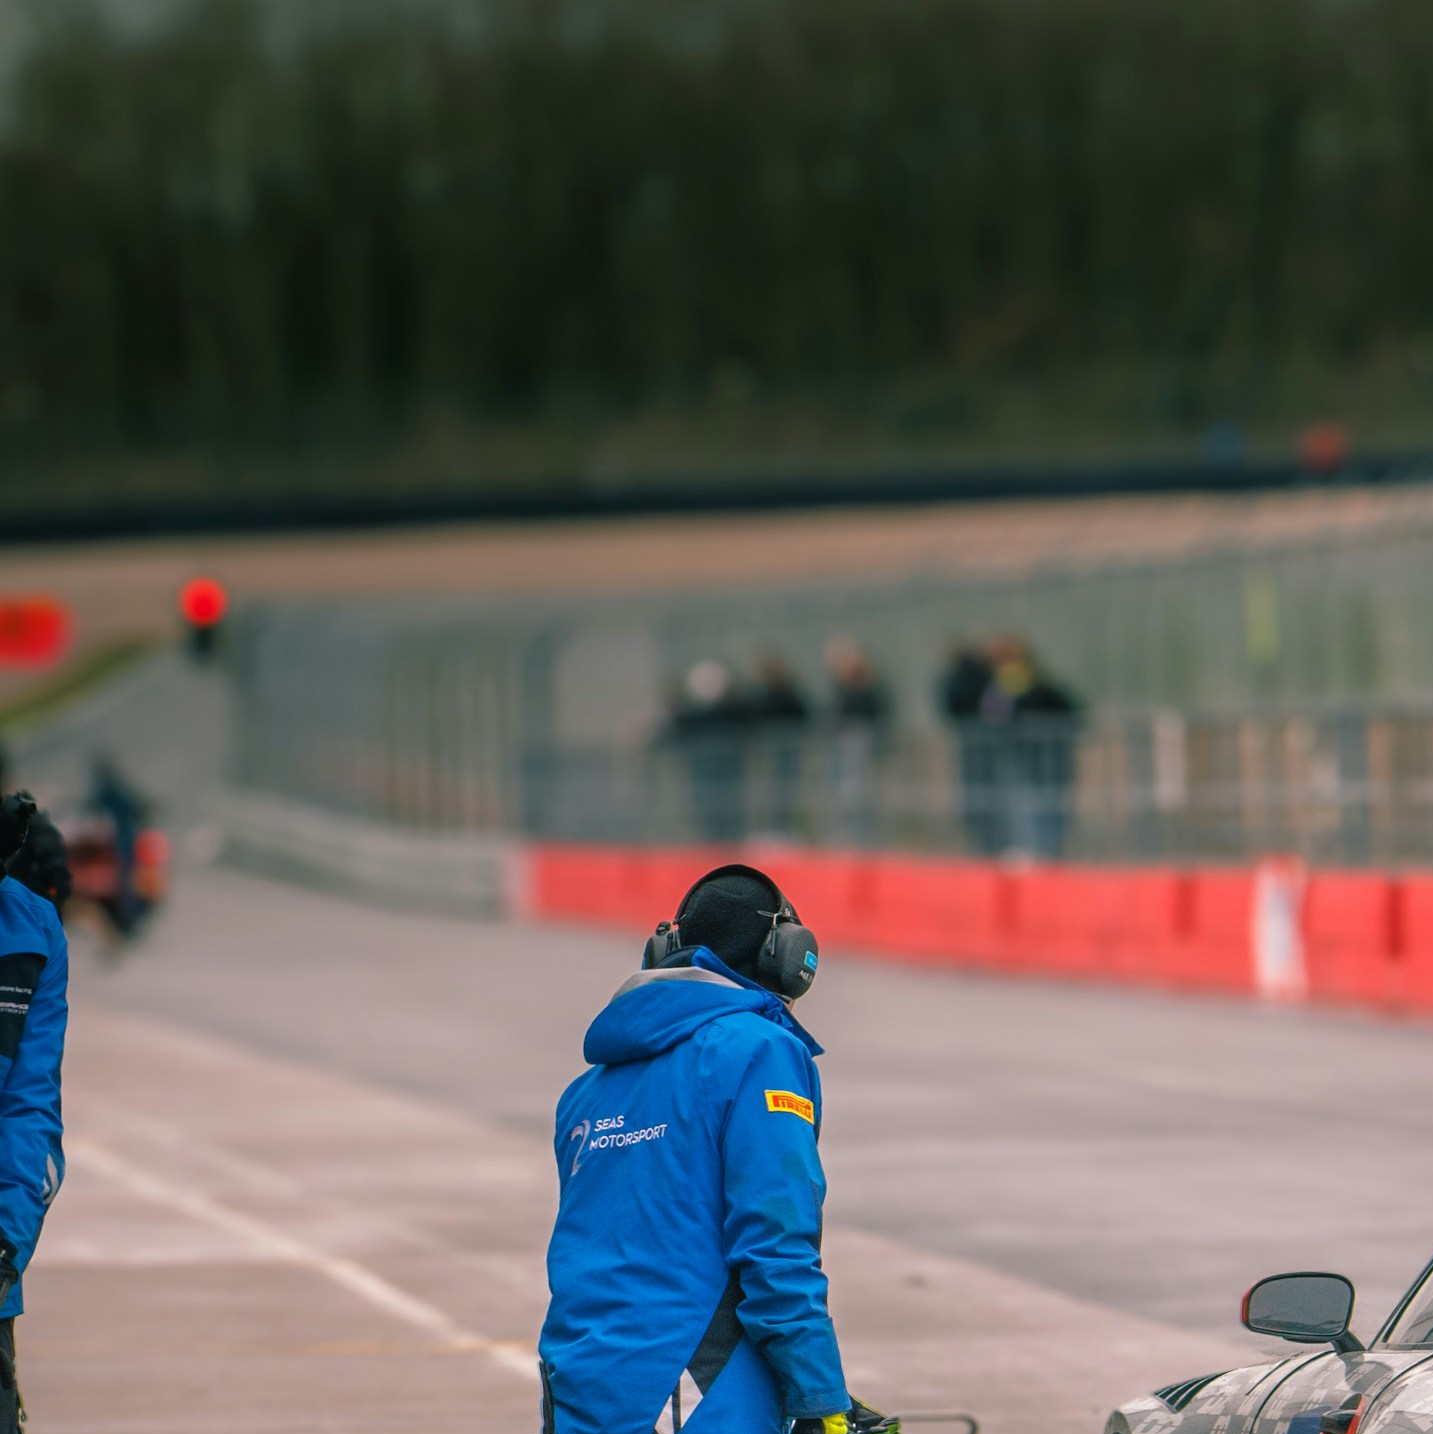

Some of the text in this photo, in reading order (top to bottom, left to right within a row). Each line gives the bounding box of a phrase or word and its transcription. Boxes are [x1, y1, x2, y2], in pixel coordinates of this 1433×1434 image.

[772, 1095, 811, 1119] PIRELLI
[594, 1115, 625, 1132] SEAS
[589, 1124, 667, 1151] MOTORSPORT
